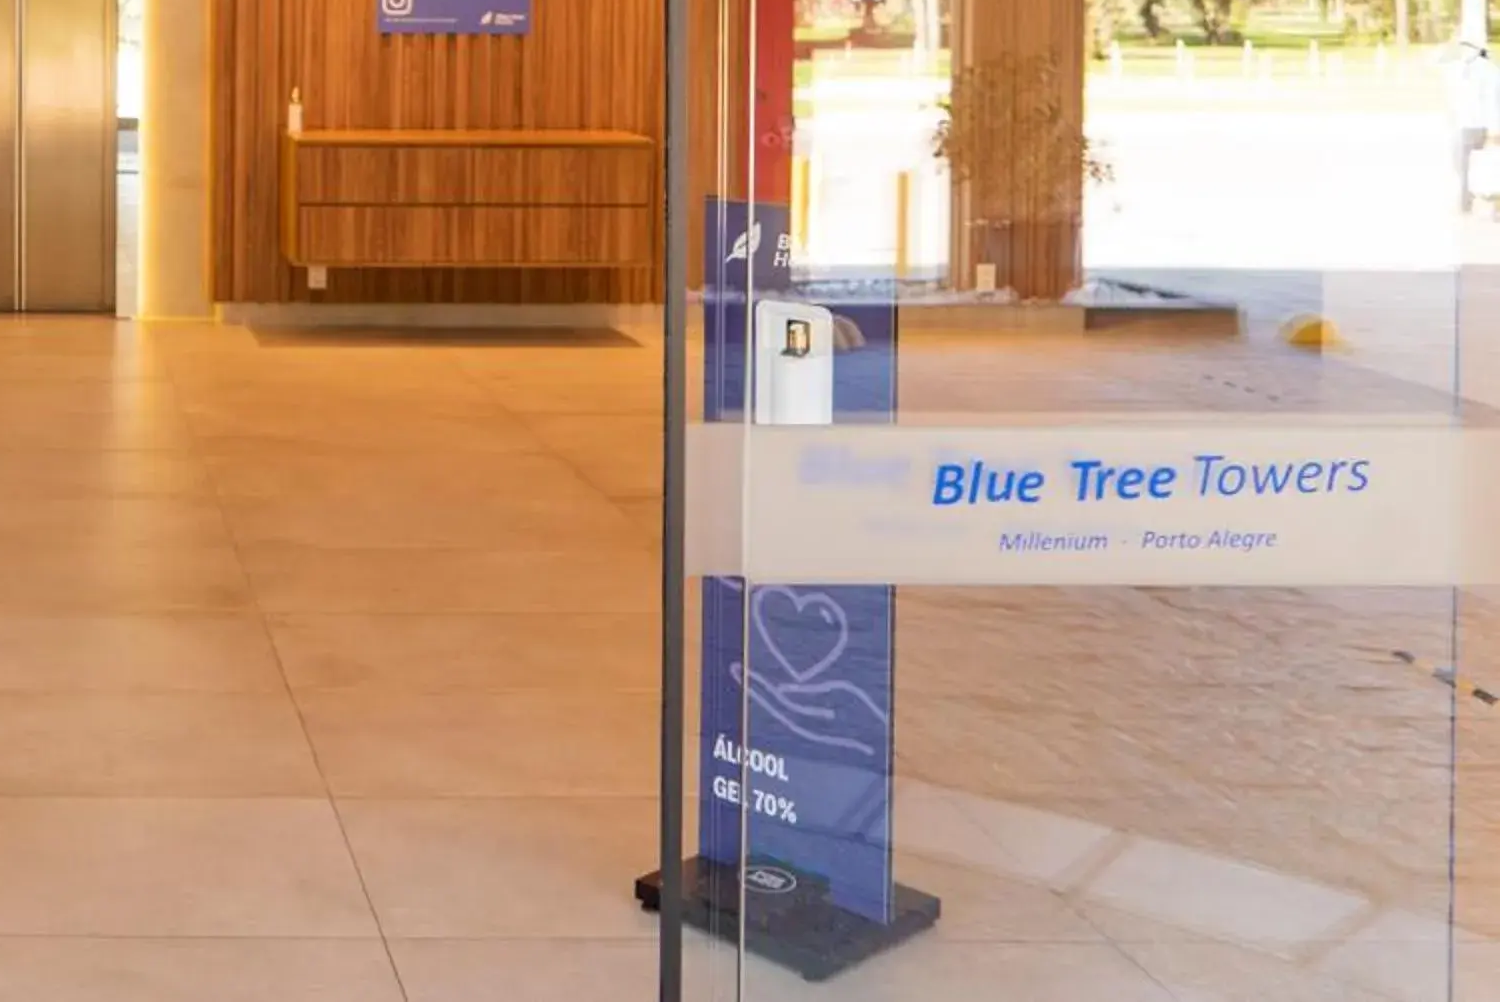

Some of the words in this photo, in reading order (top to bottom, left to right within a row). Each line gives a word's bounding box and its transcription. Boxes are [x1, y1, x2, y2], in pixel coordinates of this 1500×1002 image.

[932, 461, 1045, 505] Blue
[1071, 460, 1177, 501] Tree
[1194, 455, 1371, 496] Towers
[999, 533, 1108, 551] Millenium
[1141, 532, 1200, 549] Porto
[1206, 530, 1278, 553] Alegre
[753, 789, 797, 824] 70%
